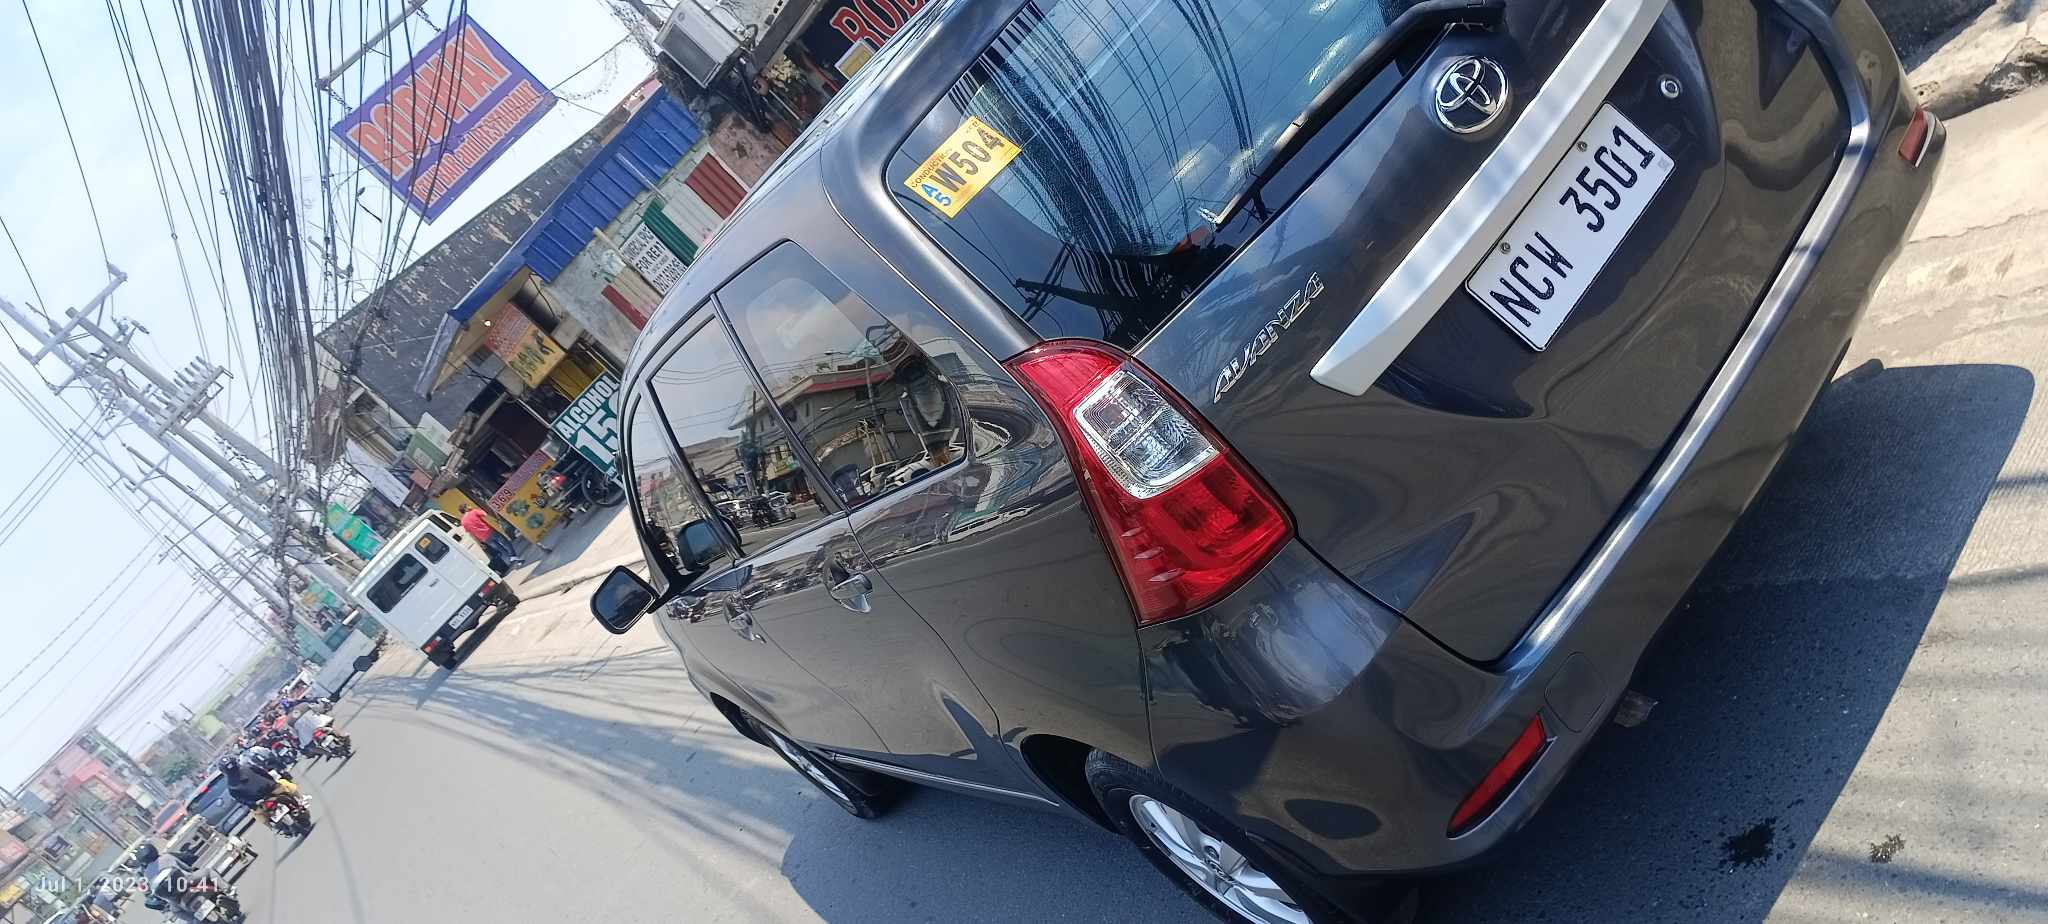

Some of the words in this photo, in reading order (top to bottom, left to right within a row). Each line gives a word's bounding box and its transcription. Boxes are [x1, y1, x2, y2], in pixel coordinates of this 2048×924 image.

[347, 24, 512, 182] RODWAY
[470, 78, 544, 151] RESTAURANT
[436, 152, 469, 189] BAR
[454, 131, 487, 169] and
[929, 127, 1004, 192] W504
[1490, 231, 1573, 327] NCW
[1559, 125, 1655, 232] 3501
[635, 255, 653, 274] FOR
[1213, 271, 1325, 404] AVANZA
[556, 375, 620, 439] ALCOHOL
